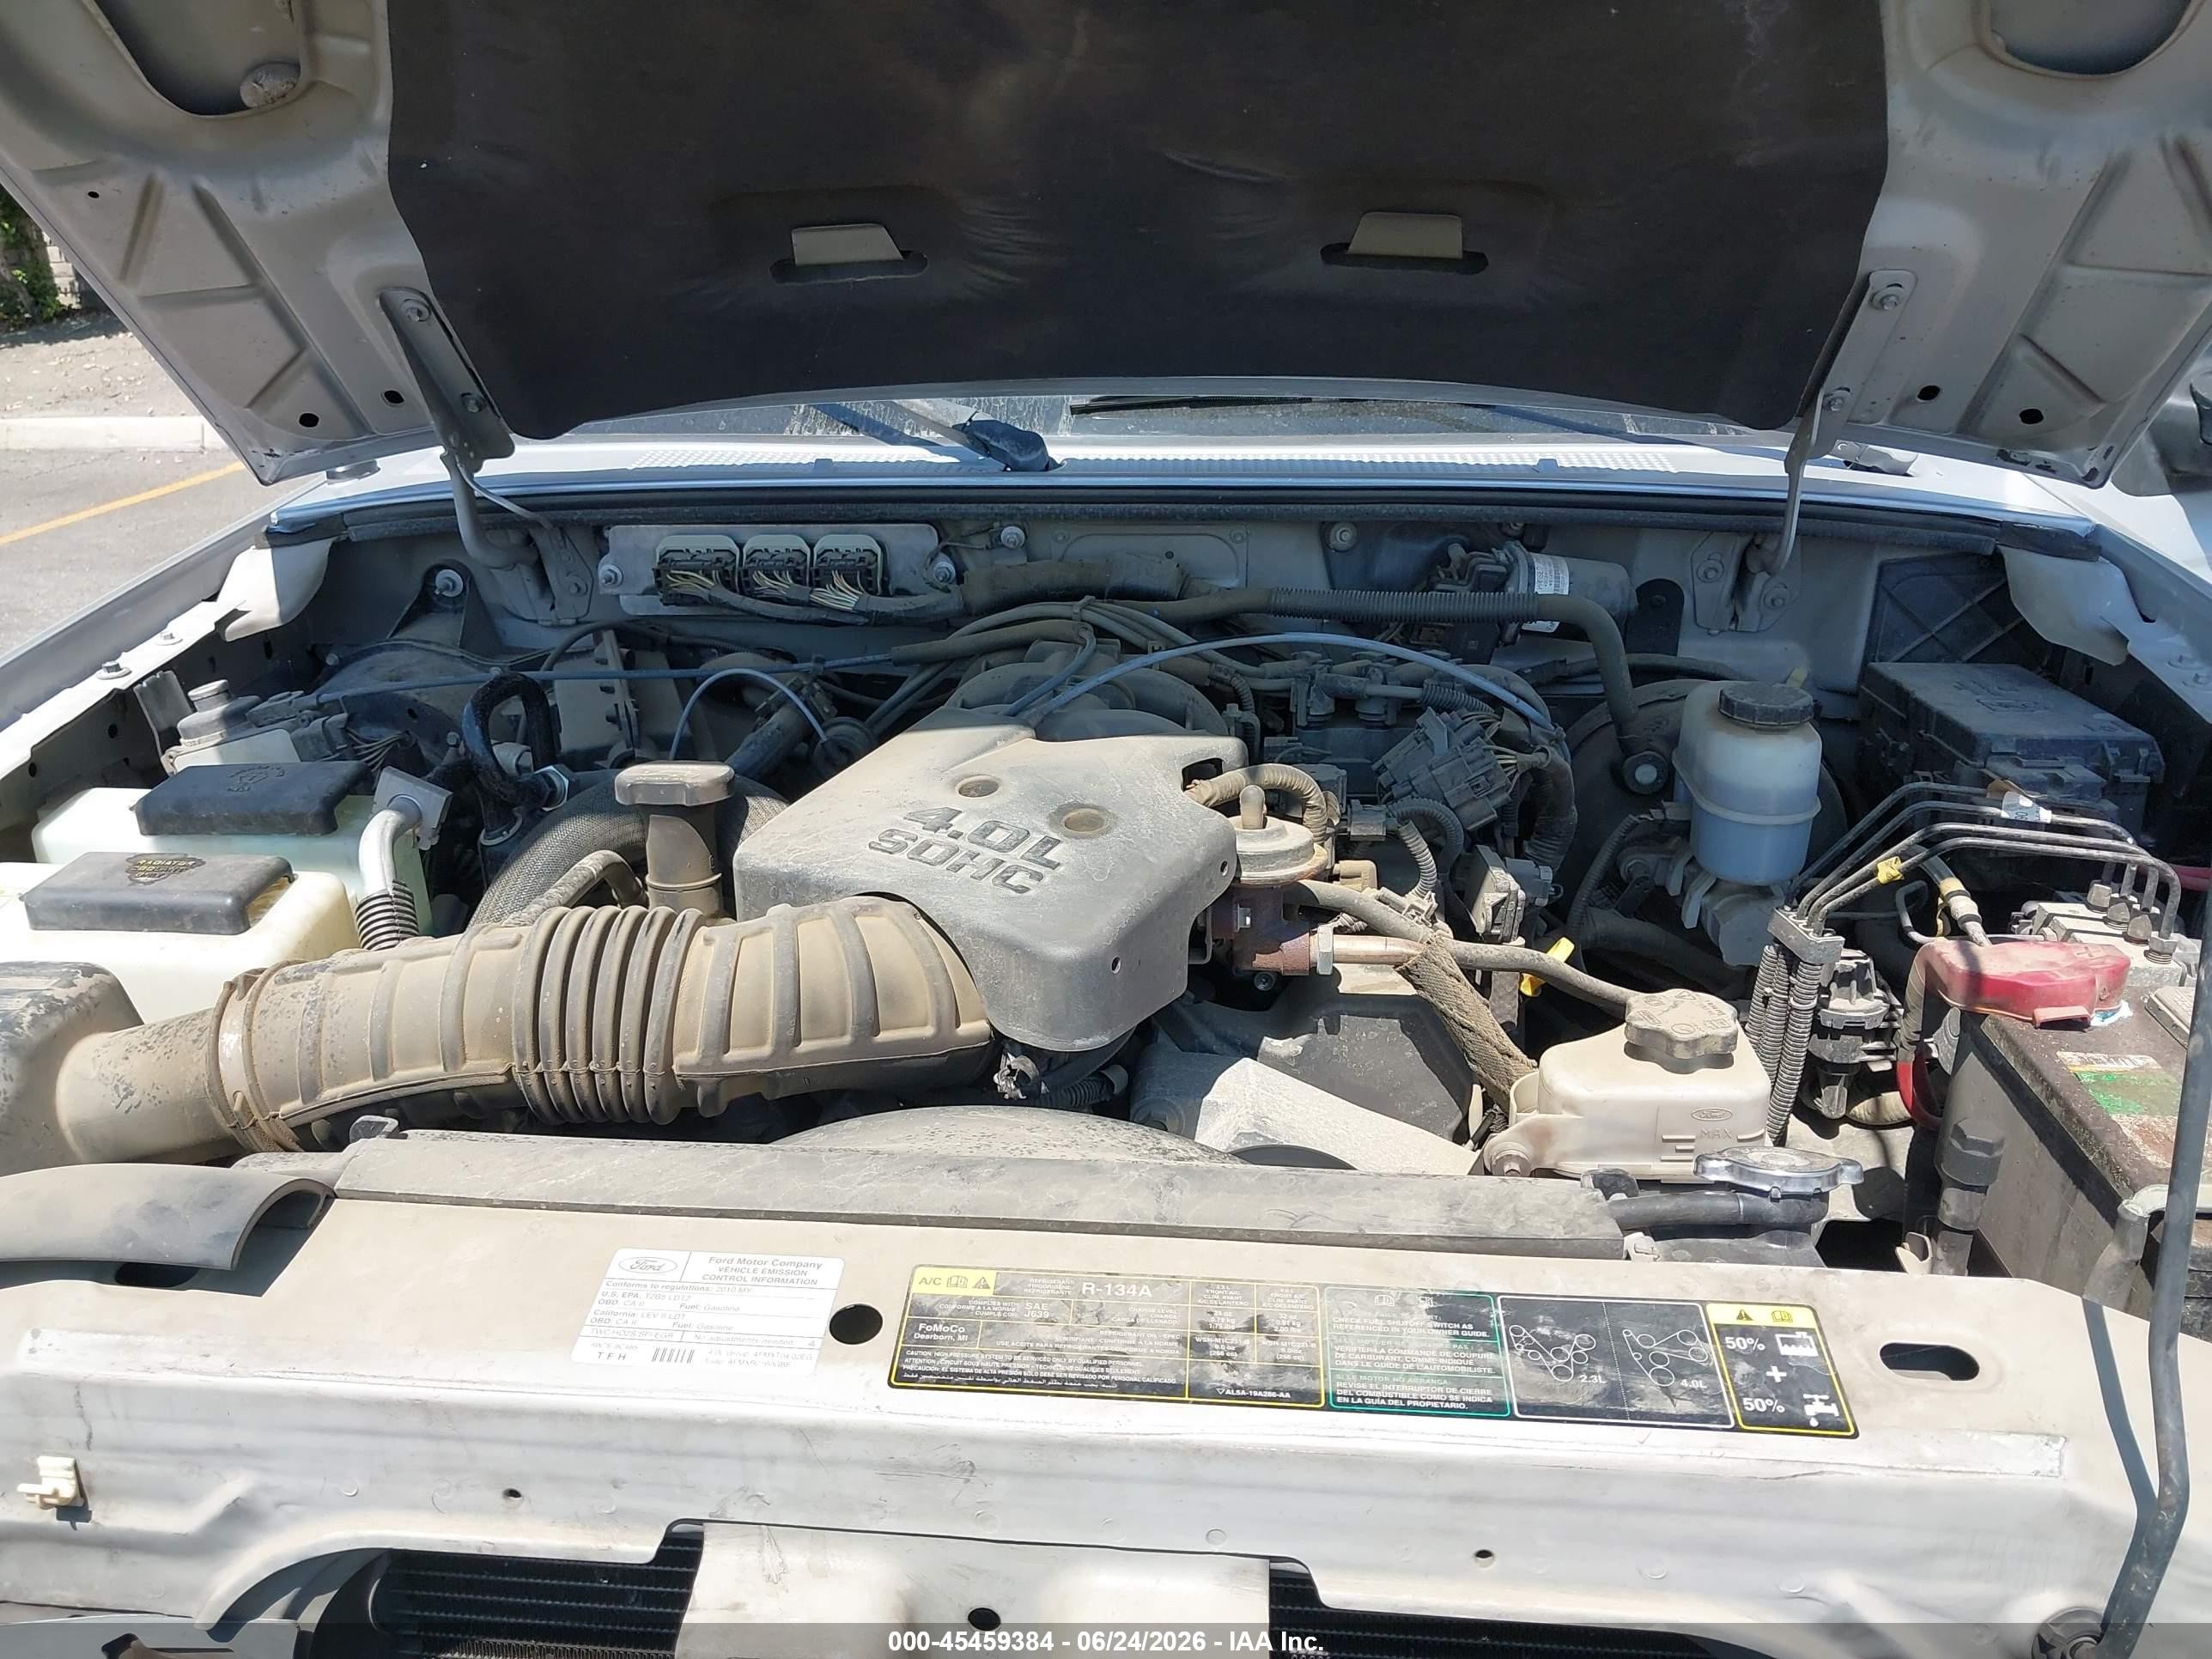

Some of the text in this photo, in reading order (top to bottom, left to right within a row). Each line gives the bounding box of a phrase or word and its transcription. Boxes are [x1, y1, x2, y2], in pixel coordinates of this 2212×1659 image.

[902, 806, 1060, 870] 4.0L
[868, 829, 1044, 894] SOHC
[1700, 1127, 1732, 1139] MAX
[629, 1258, 665, 1272] Ford
[737, 1258, 769, 1267] Motor
[771, 1259, 822, 1270] Company
[761, 1268, 808, 1277] EMISSION
[702, 1274, 817, 1285] CONTROL INFORMATION
[661, 1284, 711, 1292] regulations:
[1082, 1282, 1152, 1297] R-134A
[703, 1304, 740, 1313] Gasoline
[1024, 1302, 1048, 1310] SAE
[593, 1309, 637, 1318] California:
[672, 1321, 694, 1329] Fuel:
[696, 1322, 734, 1331] Gasoline
[919, 1323, 965, 1333] FoMoCo
[914, 1333, 956, 1341] Dearborn,
[1724, 1336, 1765, 1351] 50%
[1388, 1347, 1437, 1356] COMMANDE
[1417, 1364, 1496, 1374] L'AUTOMOBILISTE.
[1580, 1374, 1607, 1383] 2.3L
[1680, 1378, 1707, 1389] 4.0L
[1382, 1384, 1443, 1393] INTERRUPTOR
[1356, 1390, 1418, 1400] COMBUSTIBLE
[1407, 1400, 1468, 1409] PROPIETARIO.
[1742, 1397, 1785, 1413] 50%
